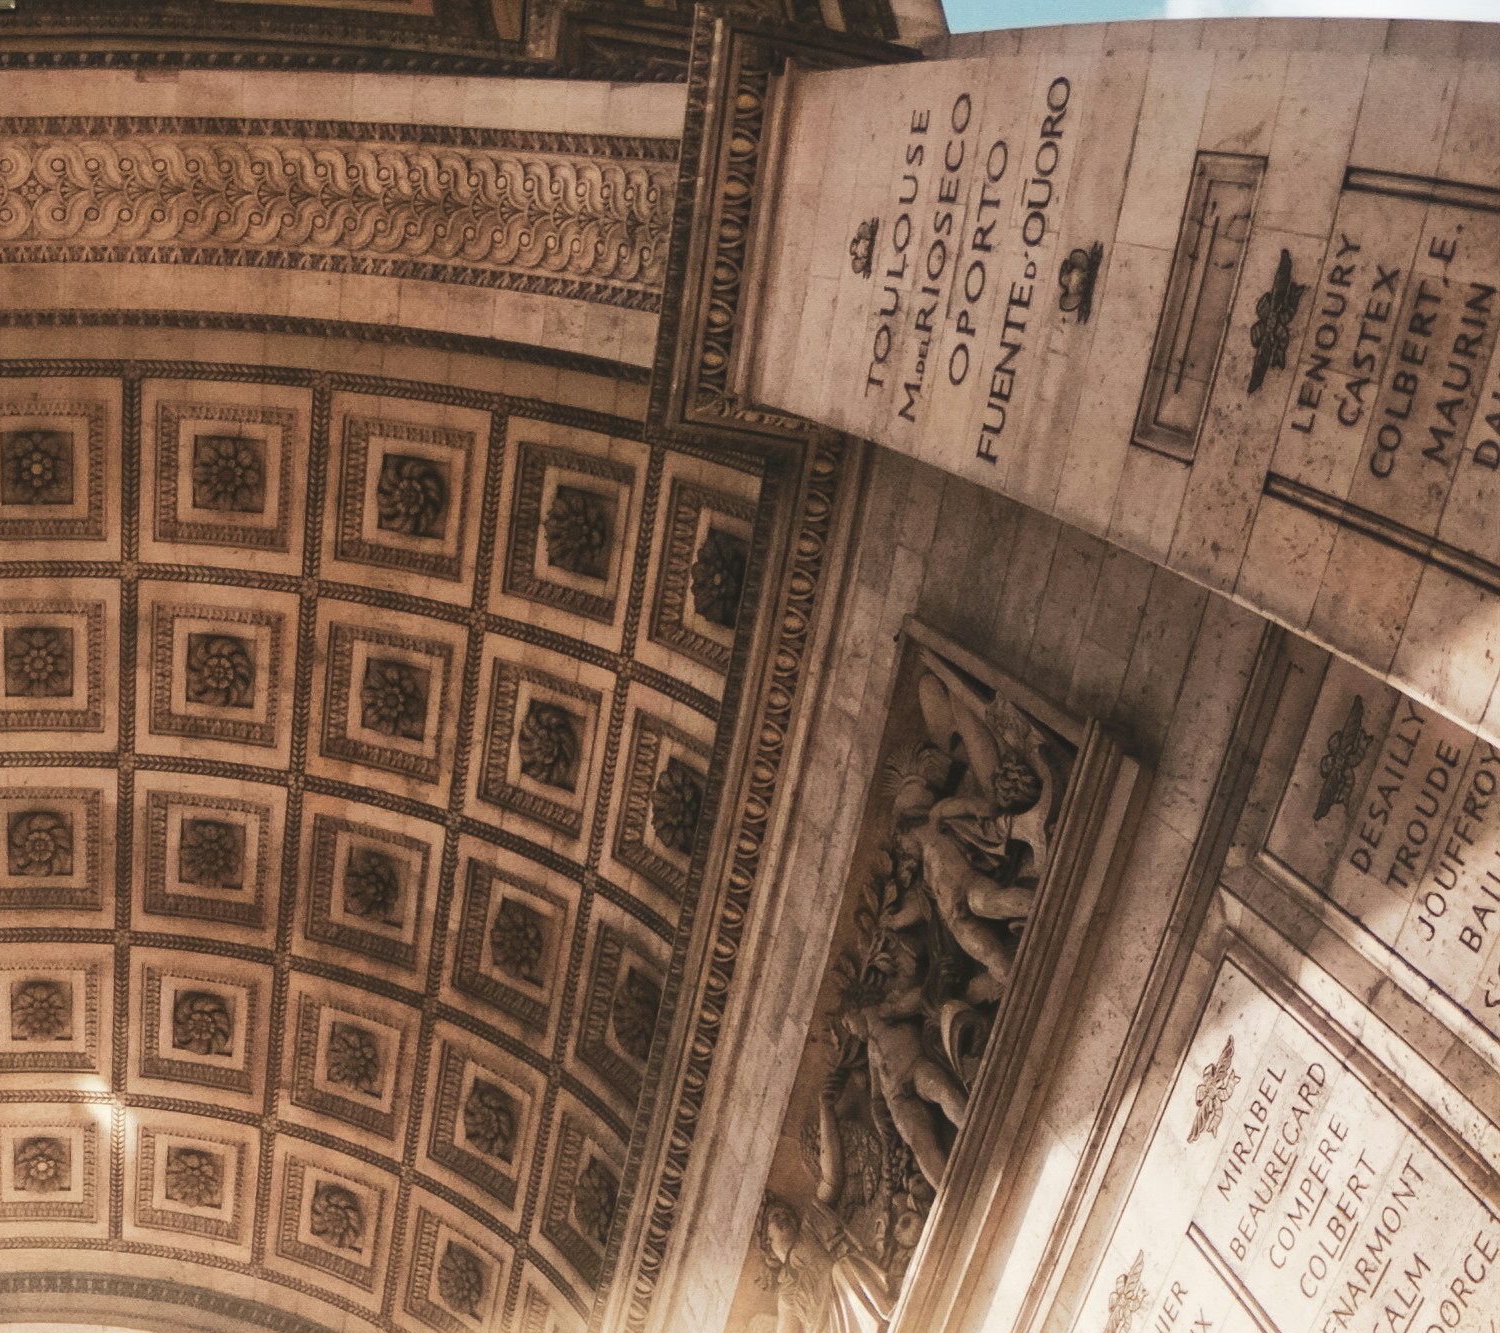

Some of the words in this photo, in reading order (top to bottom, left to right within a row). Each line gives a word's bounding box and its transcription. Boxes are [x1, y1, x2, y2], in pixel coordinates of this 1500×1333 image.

[865, 108, 930, 397] TOULOUSE
[948, 140, 1008, 386] OPORTO
[1291, 233, 1360, 434] LENOURY
[976, 281, 1034, 464] FUENTE
[1337, 264, 1400, 427] CASTEX
[1422, 282, 1497, 466] MAURIN
[1350, 700, 1426, 874] DESAILLY
[1386, 739, 1461, 889] TROUDE
[1419, 744, 1500, 941] JOUFFROY
[1217, 1067, 1287, 1201] MIRABEL
[1269, 1113, 1350, 1269] COMPERE
[1300, 1148, 1376, 1298] COLBERT
